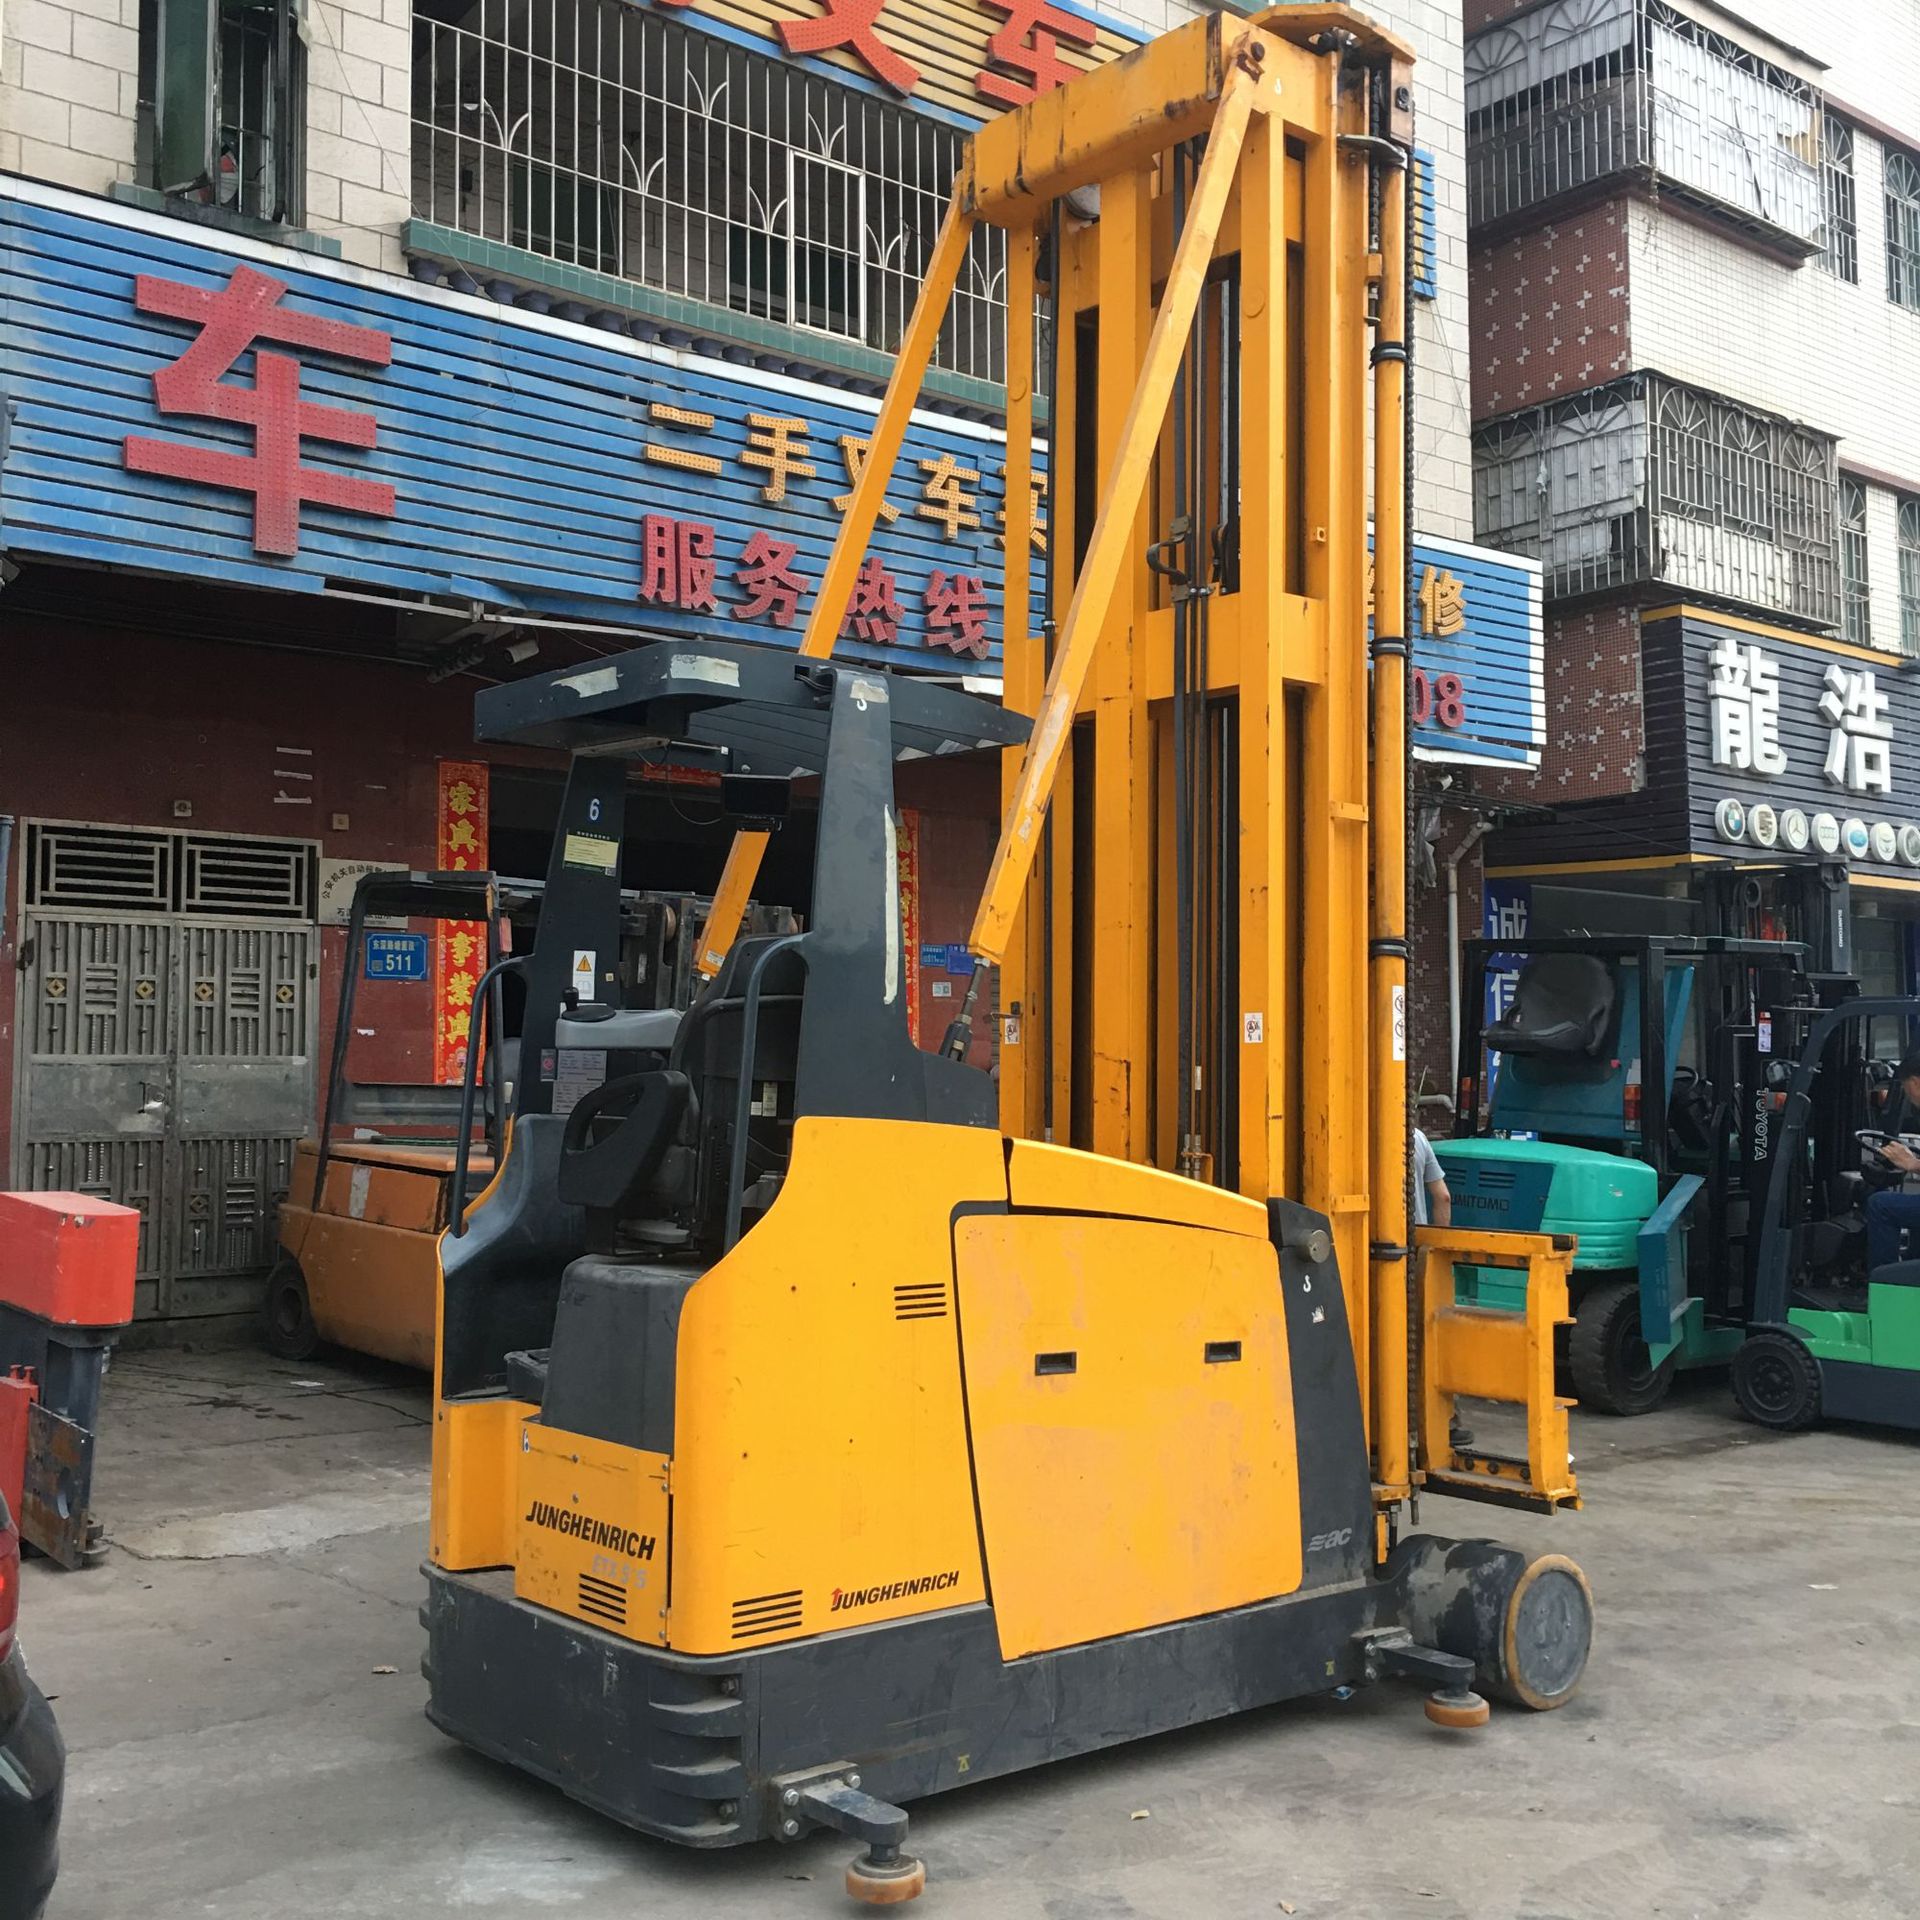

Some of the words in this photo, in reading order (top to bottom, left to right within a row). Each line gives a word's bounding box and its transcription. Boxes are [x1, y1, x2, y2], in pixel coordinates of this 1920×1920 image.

[123, 265, 395, 557] 车
[638, 514, 990, 661] 服务热线
[1707, 639, 1894, 794] 龍浩
[589, 798, 600, 820] 6
[386, 954, 411, 972] 511
[1754, 1088, 1769, 1161] TOYOTA
[525, 1501, 656, 1560] JUNGHEINRICH
[831, 1570, 960, 1612] JUNGHEINRICH
